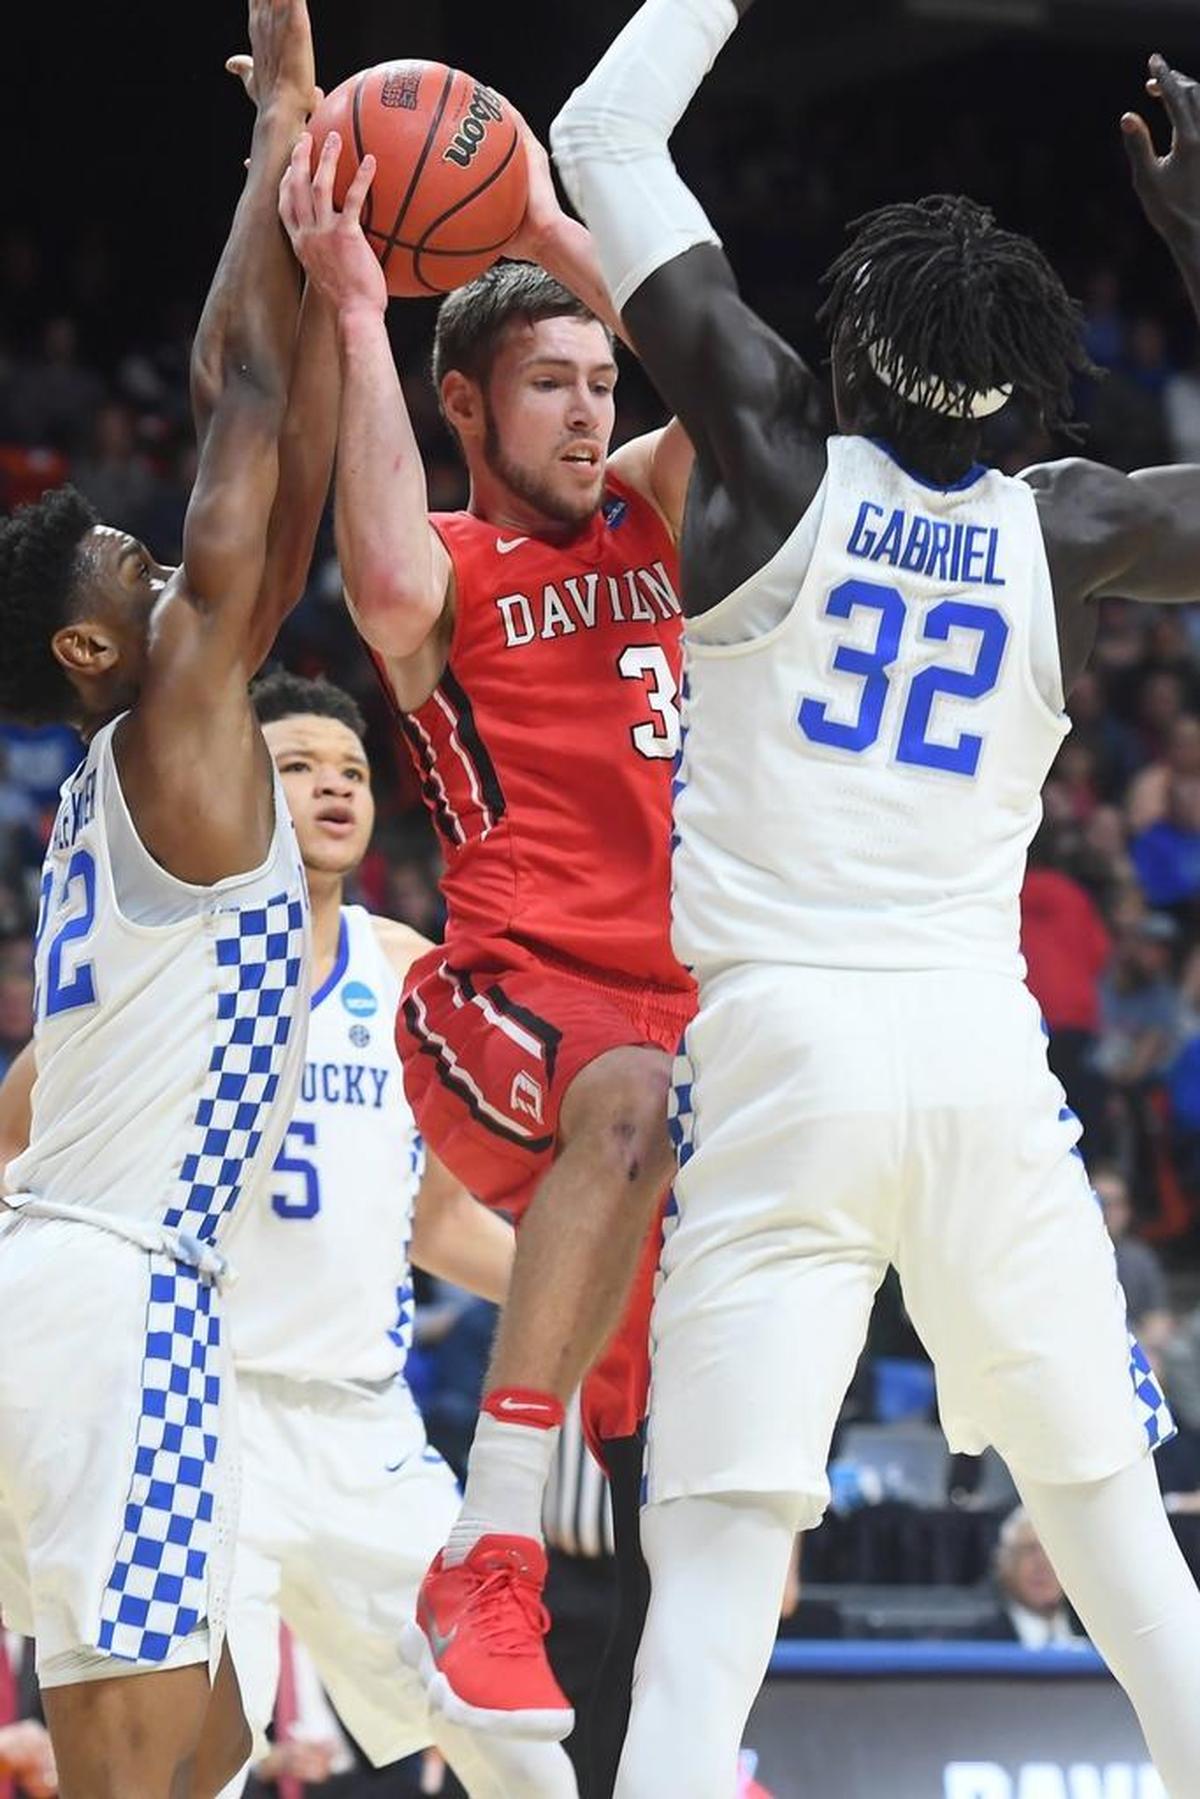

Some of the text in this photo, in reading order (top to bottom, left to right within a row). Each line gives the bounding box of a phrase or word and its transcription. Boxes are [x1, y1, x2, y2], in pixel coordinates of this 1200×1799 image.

[846, 500, 1006, 586] GABRIEL
[617, 643, 682, 759] 3
[797, 578, 1009, 778] 32
[271, 1121, 320, 1220] 5
